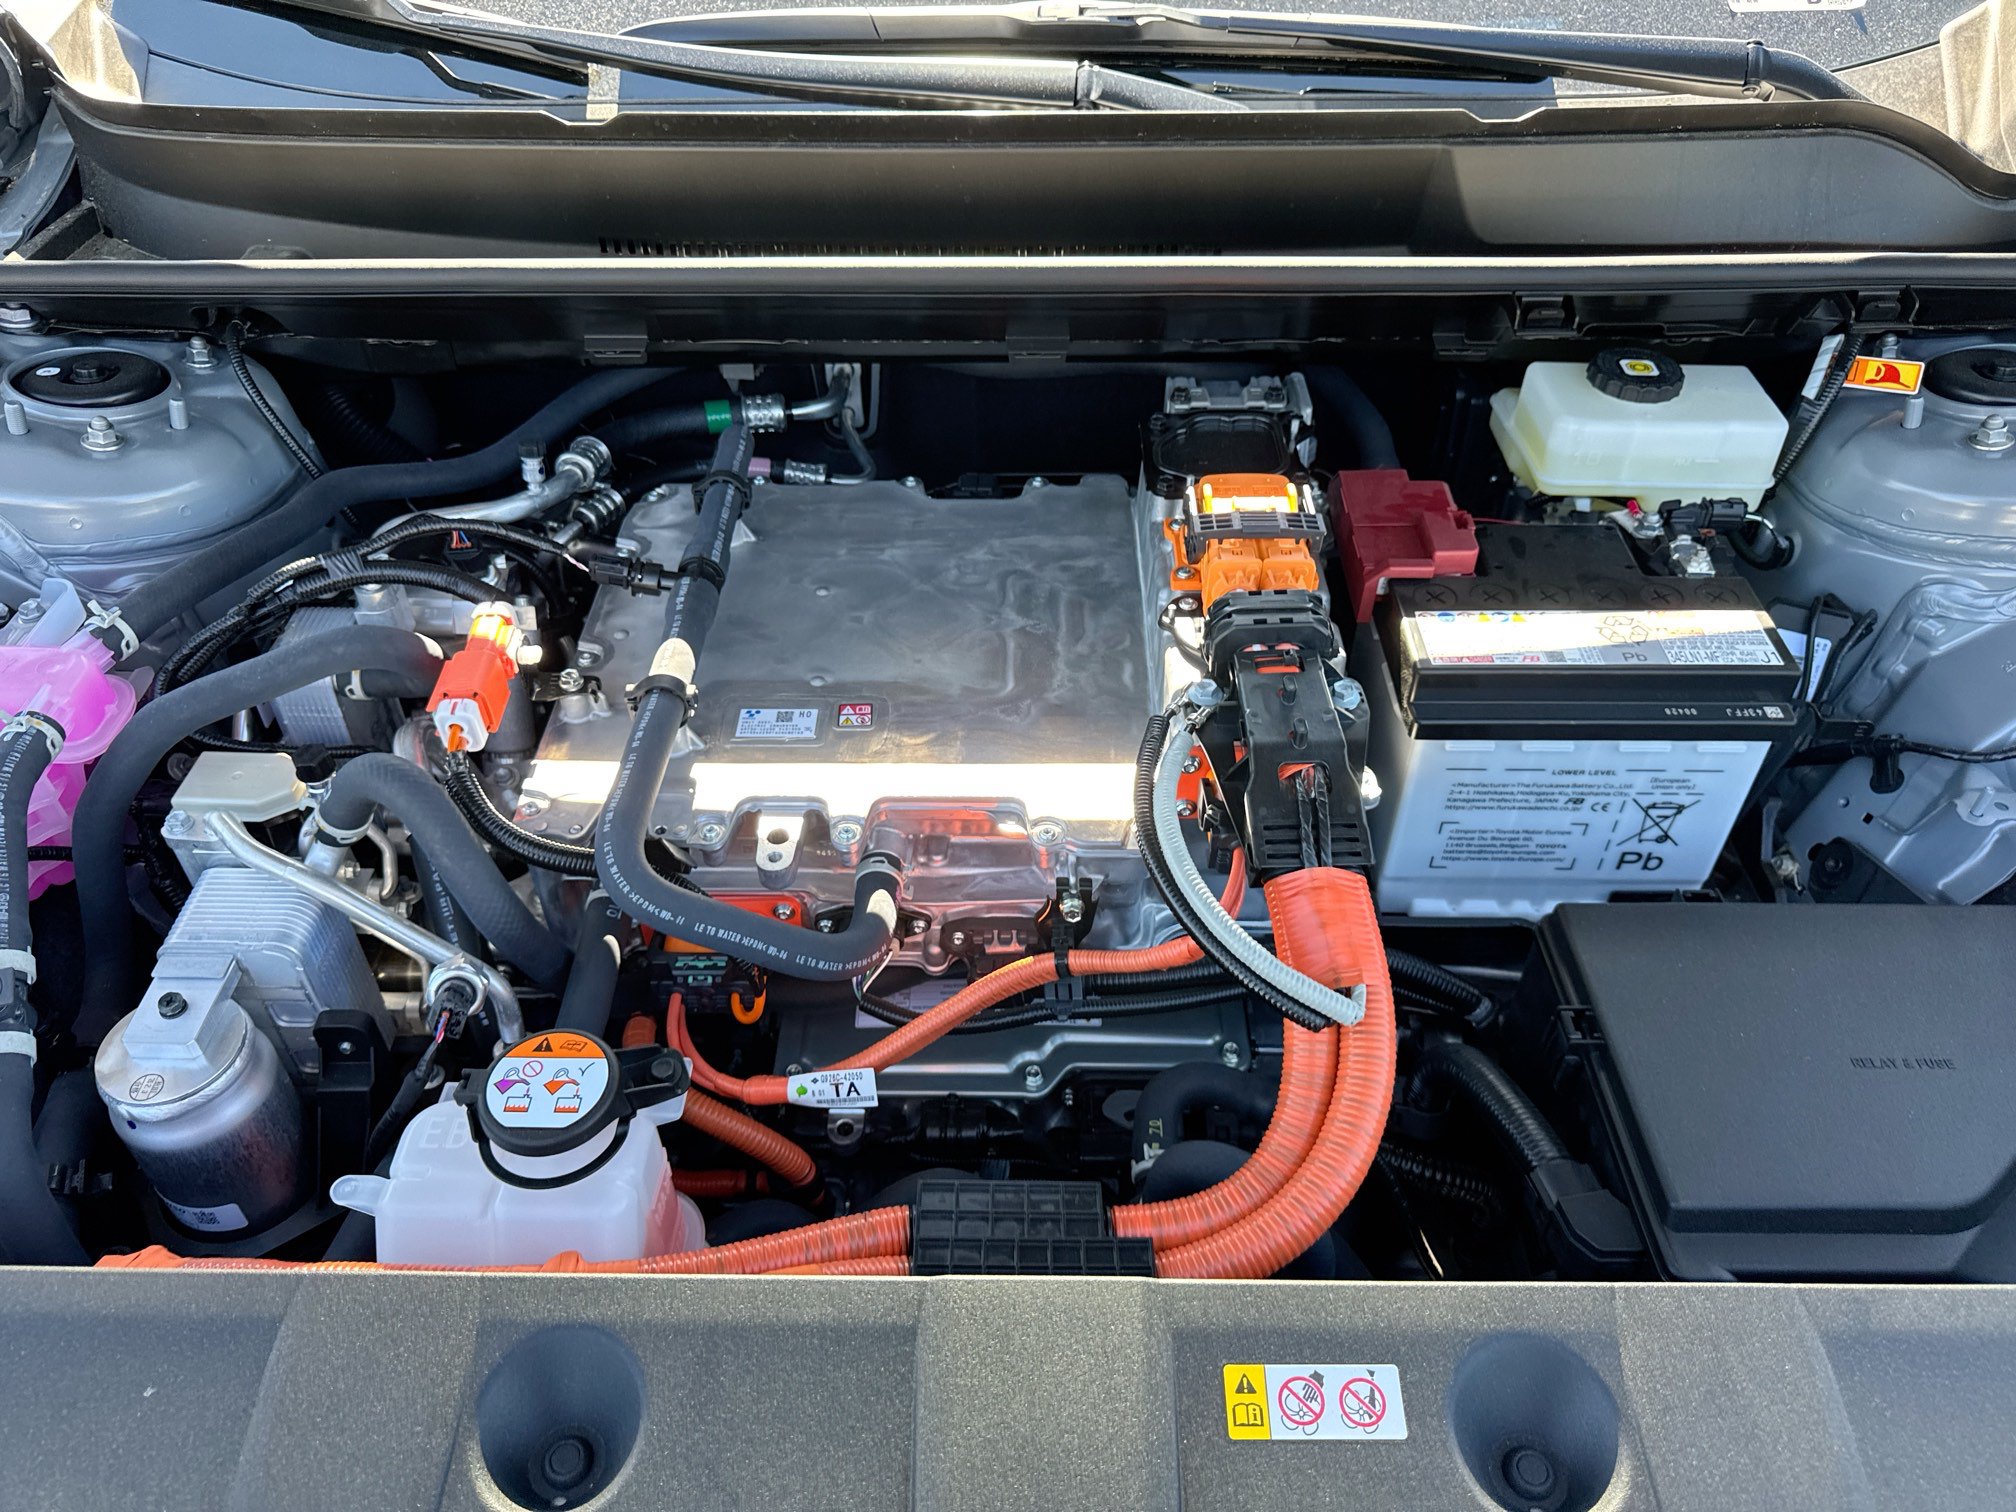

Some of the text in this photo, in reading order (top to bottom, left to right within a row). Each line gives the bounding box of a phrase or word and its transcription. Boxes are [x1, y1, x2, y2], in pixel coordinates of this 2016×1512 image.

[1622, 651, 1648, 662] Pb
[1615, 852, 1664, 871] Pb
[609, 864, 631, 894] WATER
[717, 927, 742, 943] WATER
[818, 960, 843, 971] WATER
[1849, 1056, 1898, 1070] RELAY
[1915, 1057, 1958, 1070] FUSE
[830, 1081, 861, 1098] TA
